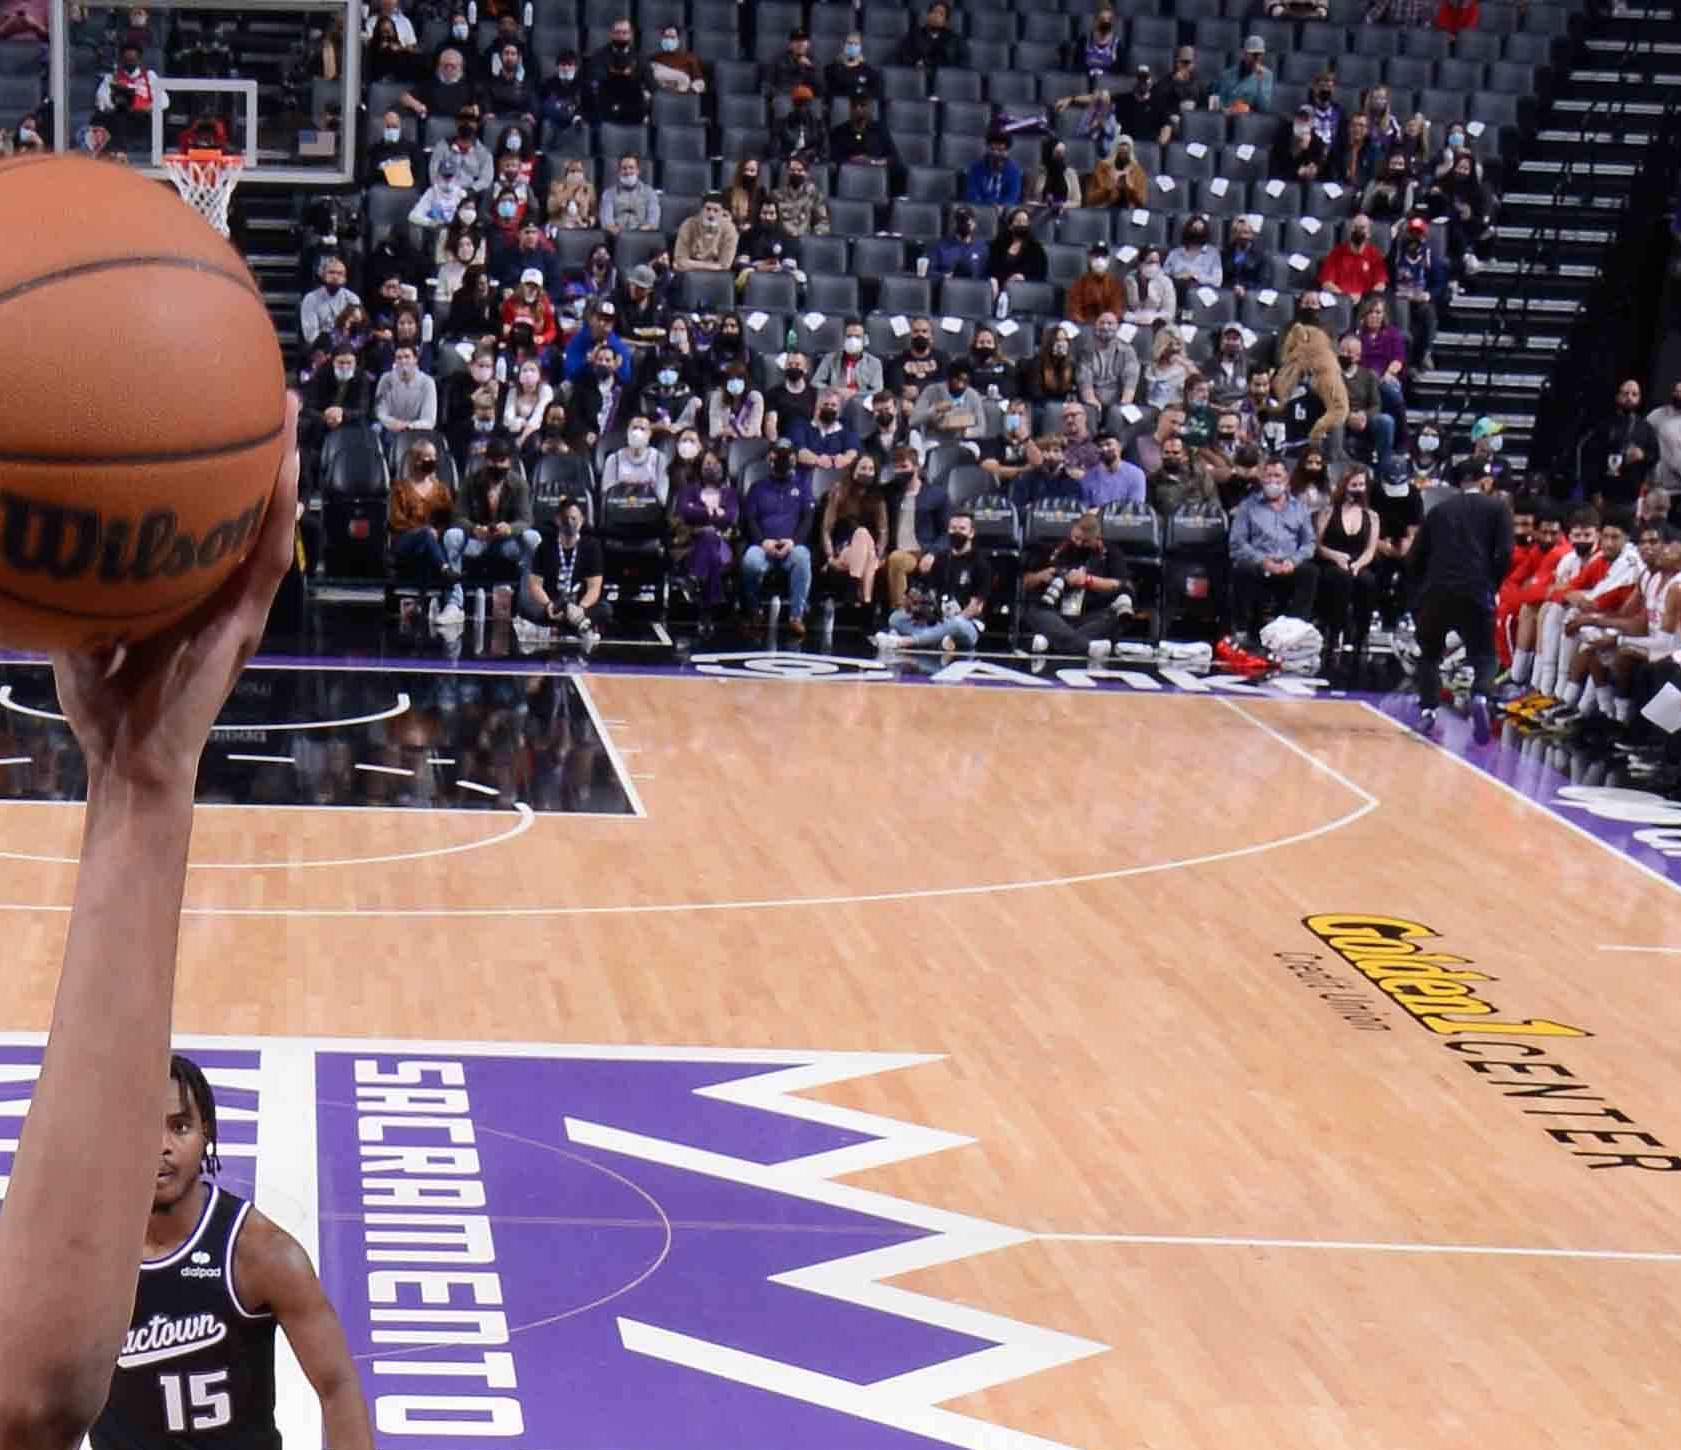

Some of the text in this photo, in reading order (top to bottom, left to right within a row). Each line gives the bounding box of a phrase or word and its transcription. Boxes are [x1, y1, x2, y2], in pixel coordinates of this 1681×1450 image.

[180, 1266, 222, 1279] dialpad
[353, 1059, 525, 1437] SACRAMENTO
[120, 1312, 227, 1367] actown
[159, 1369, 232, 1432] 15
